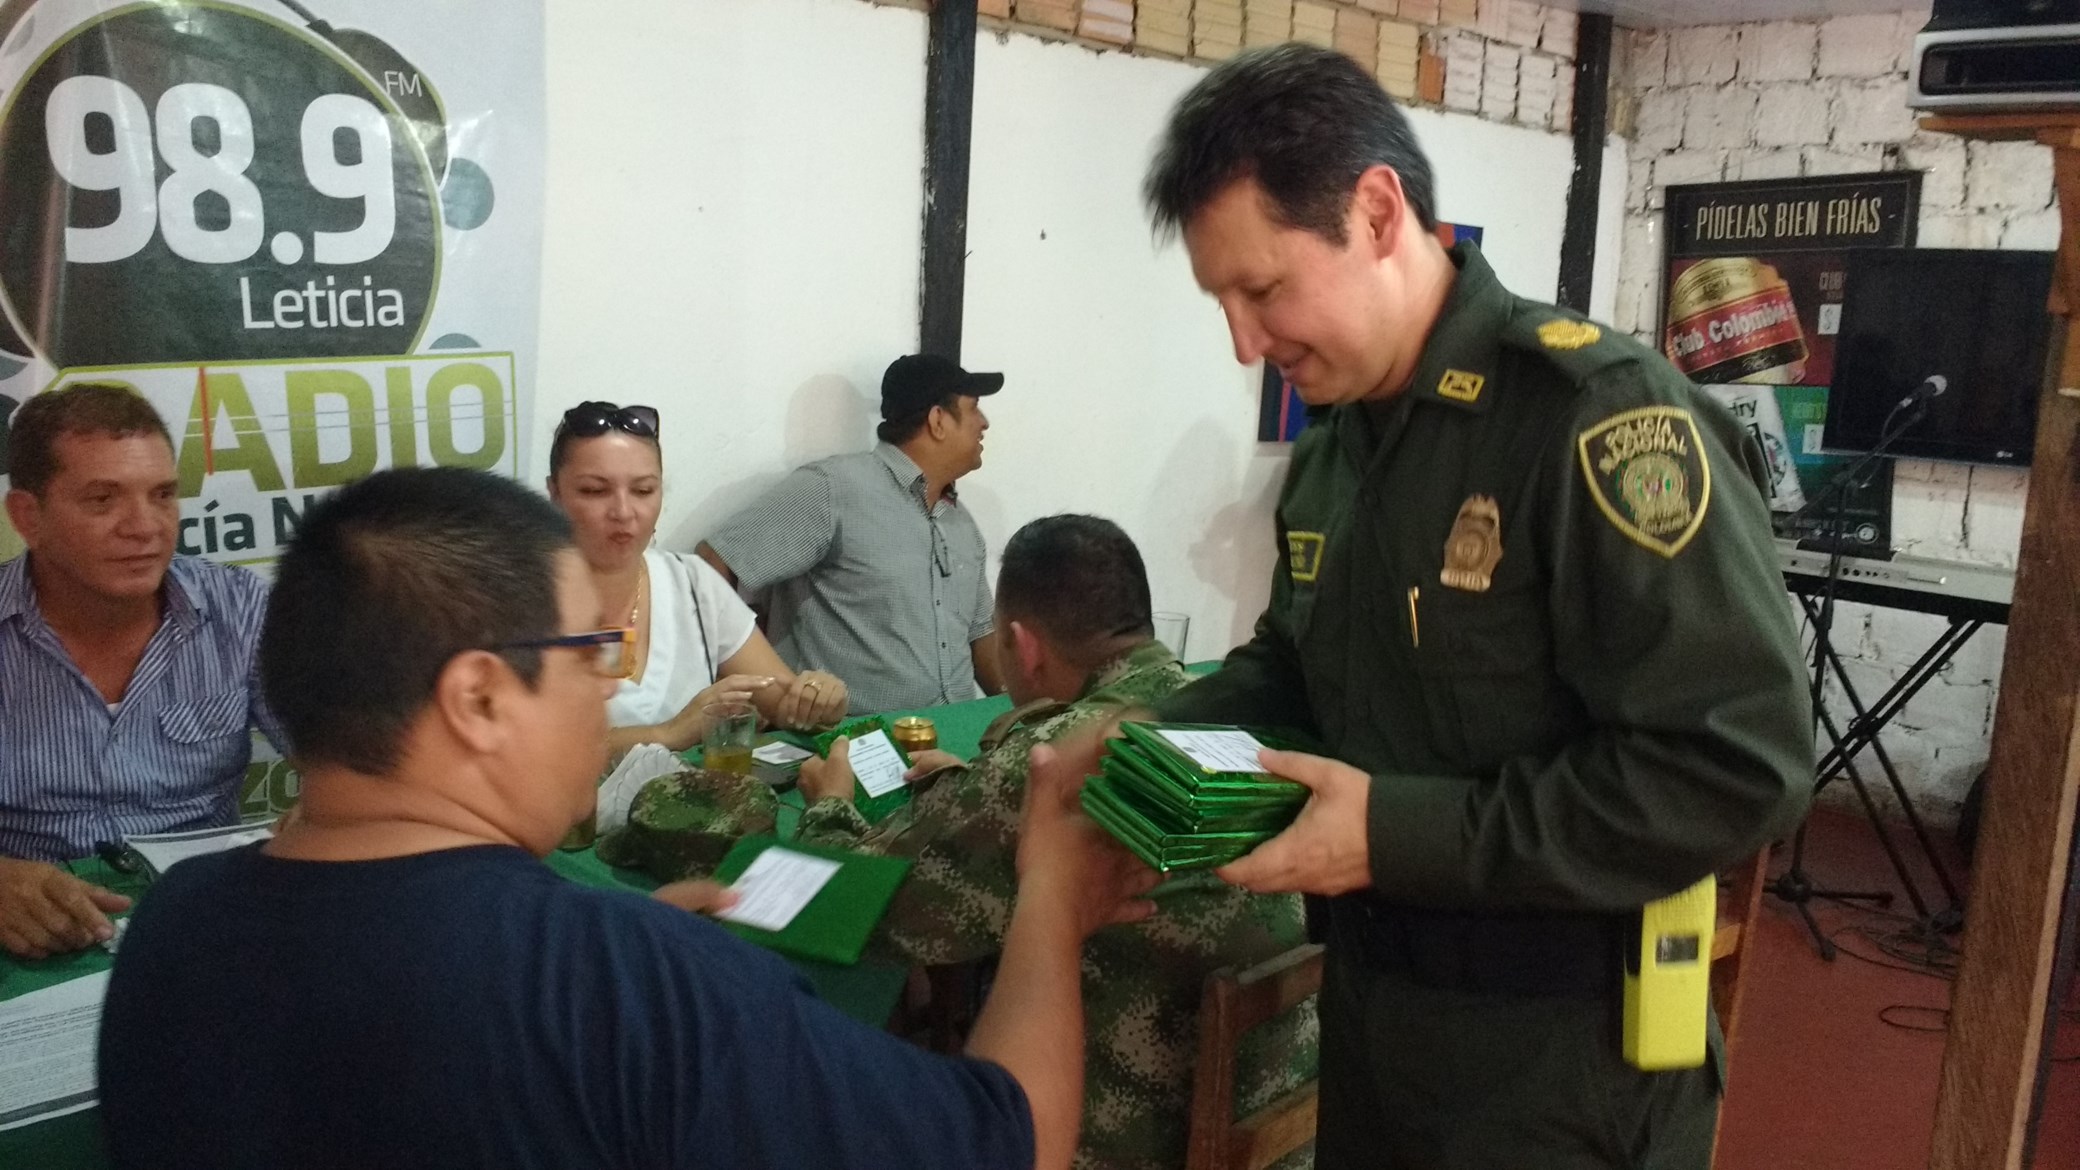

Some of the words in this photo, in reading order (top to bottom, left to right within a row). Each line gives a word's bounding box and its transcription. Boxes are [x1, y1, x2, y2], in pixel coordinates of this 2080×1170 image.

[384, 71, 423, 98] FM
[46, 75, 396, 265] 98.9
[1774, 201, 1820, 238] BIEN
[1826, 192, 1882, 235] FRÍAS
[240, 275, 404, 330] Leticia
[58, 363, 505, 498] ADIO
